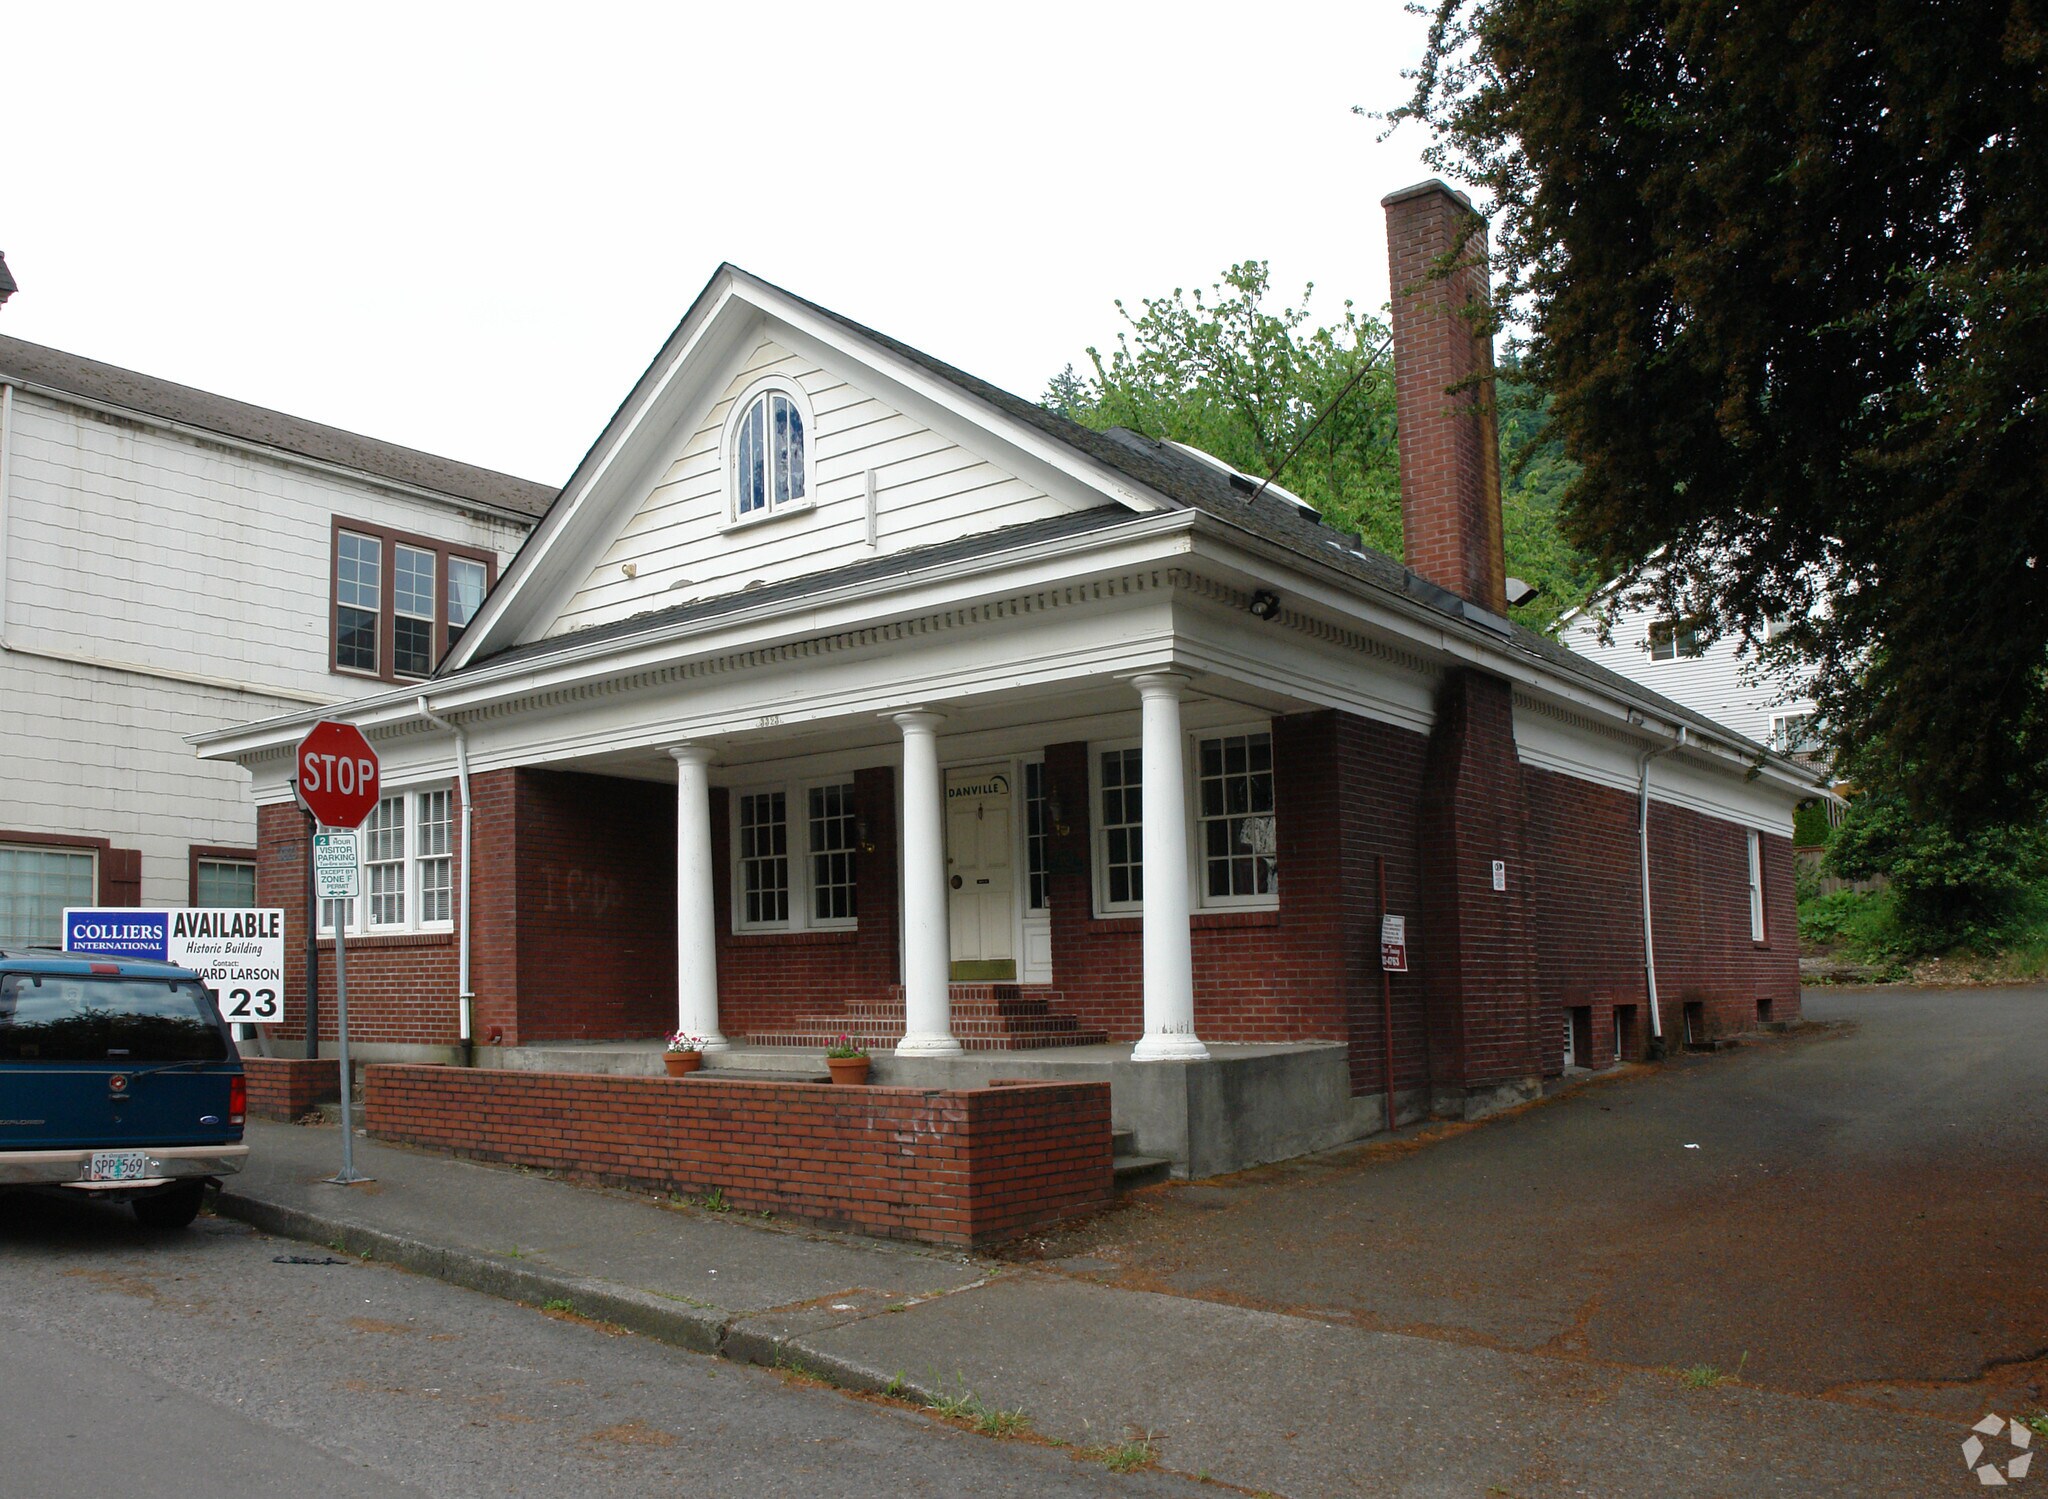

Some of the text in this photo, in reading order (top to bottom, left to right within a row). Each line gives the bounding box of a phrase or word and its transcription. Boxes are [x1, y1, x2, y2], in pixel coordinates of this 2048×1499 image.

[303, 752, 375, 797] STOP
[948, 783, 999, 798] DANVILLE
[319, 837, 327, 846] 2
[319, 846, 352, 854] VISITOR
[317, 853, 355, 862] PARKING
[320, 875, 345, 883] ZONE
[73, 924, 163, 940] COLLIERS
[172, 912, 280, 939] AVAILABLE
[73, 941, 163, 950] INTERNATIONAL
[186, 940, 263, 957] Historic Building
[212, 959, 240, 967] Contact:
[230, 968, 280, 981] LARSON
[94, 1158, 143, 1174] SPP 569
